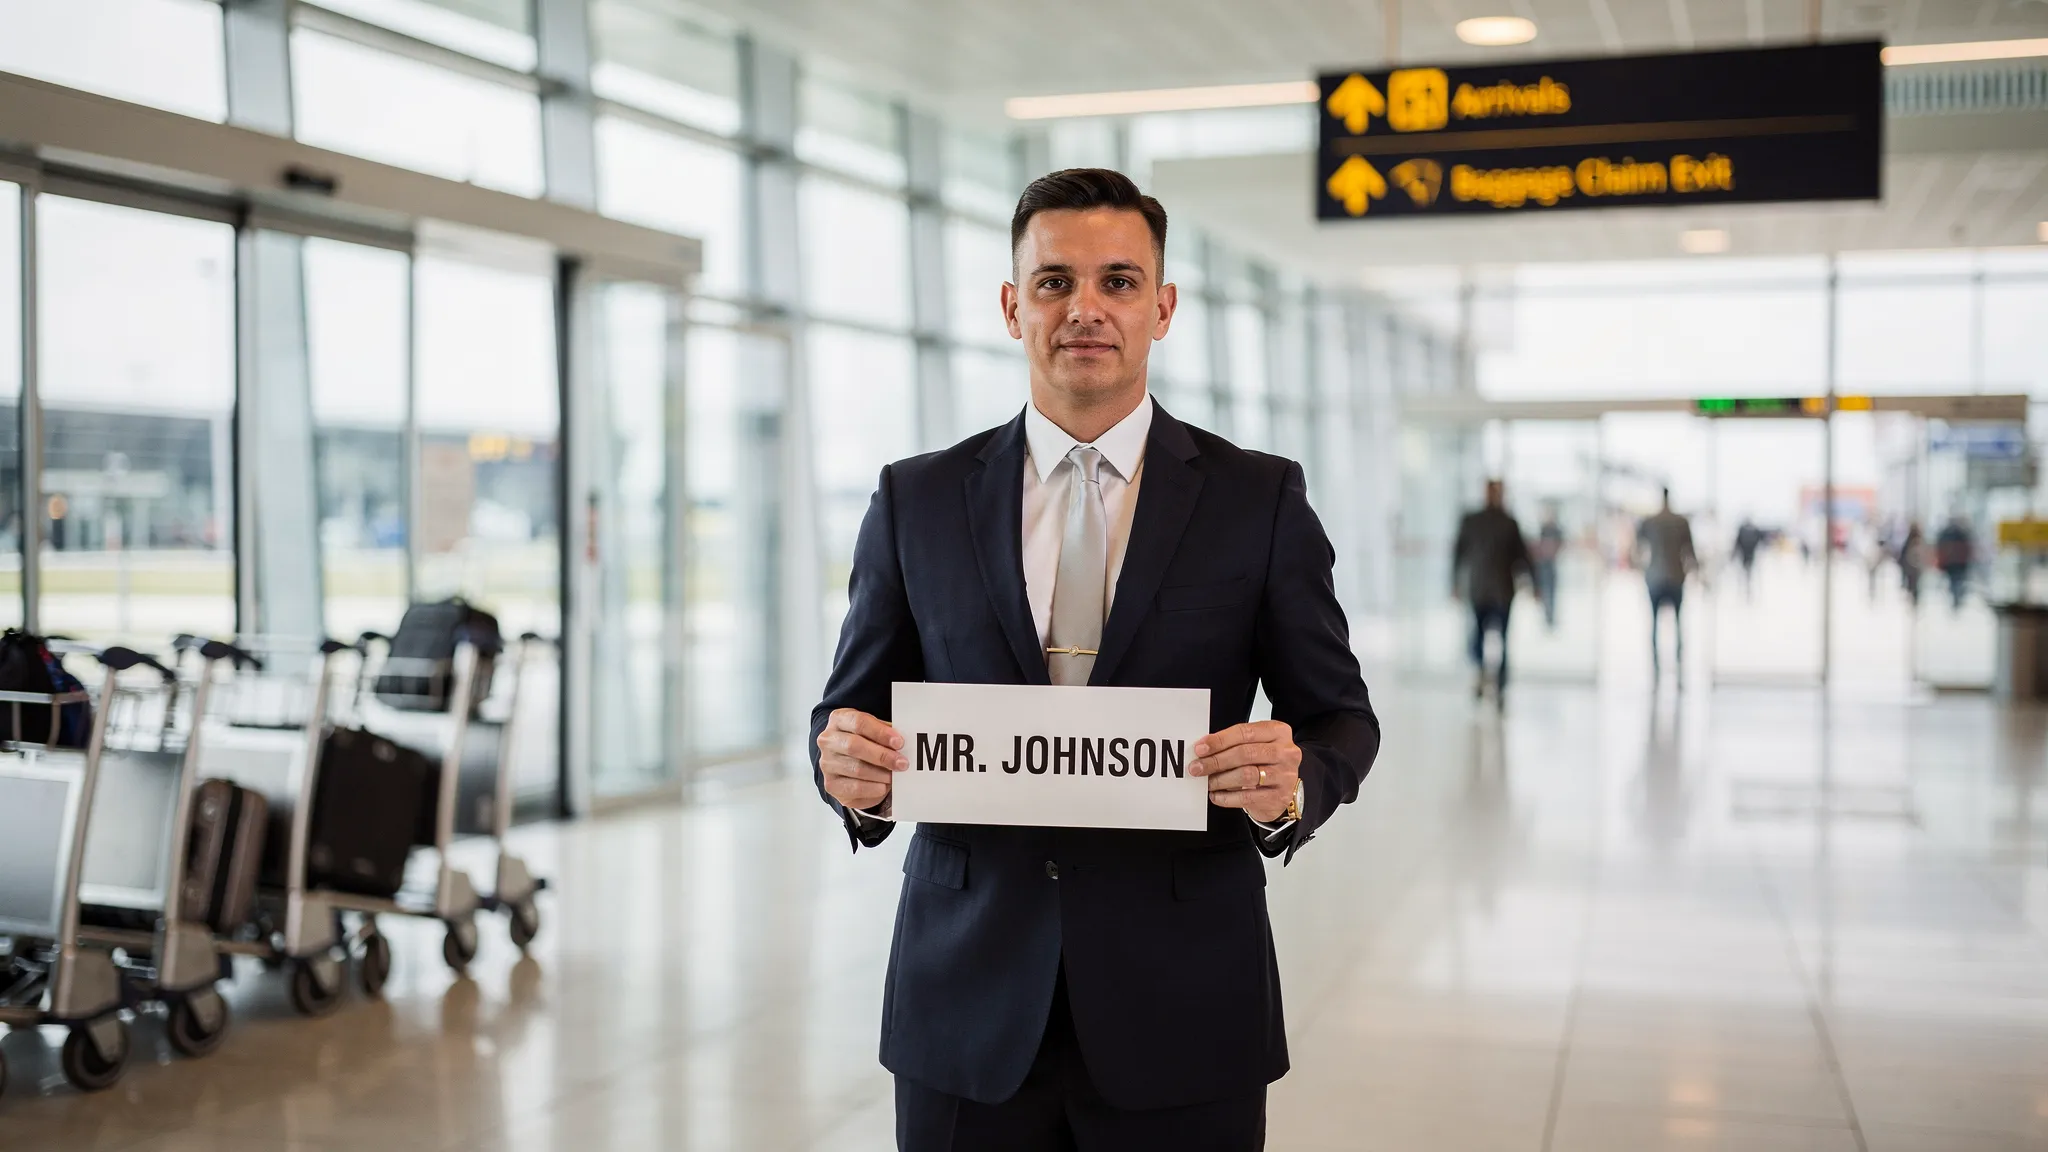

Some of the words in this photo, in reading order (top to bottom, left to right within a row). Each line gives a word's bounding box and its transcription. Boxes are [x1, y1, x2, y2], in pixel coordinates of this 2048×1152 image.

[1452, 77, 1571, 118] Arrivals
[1575, 158, 1667, 195] Claim
[1670, 154, 1734, 192] Exit
[916, 732, 987, 773] MR.
[1001, 735, 1185, 779] JOHNSON
